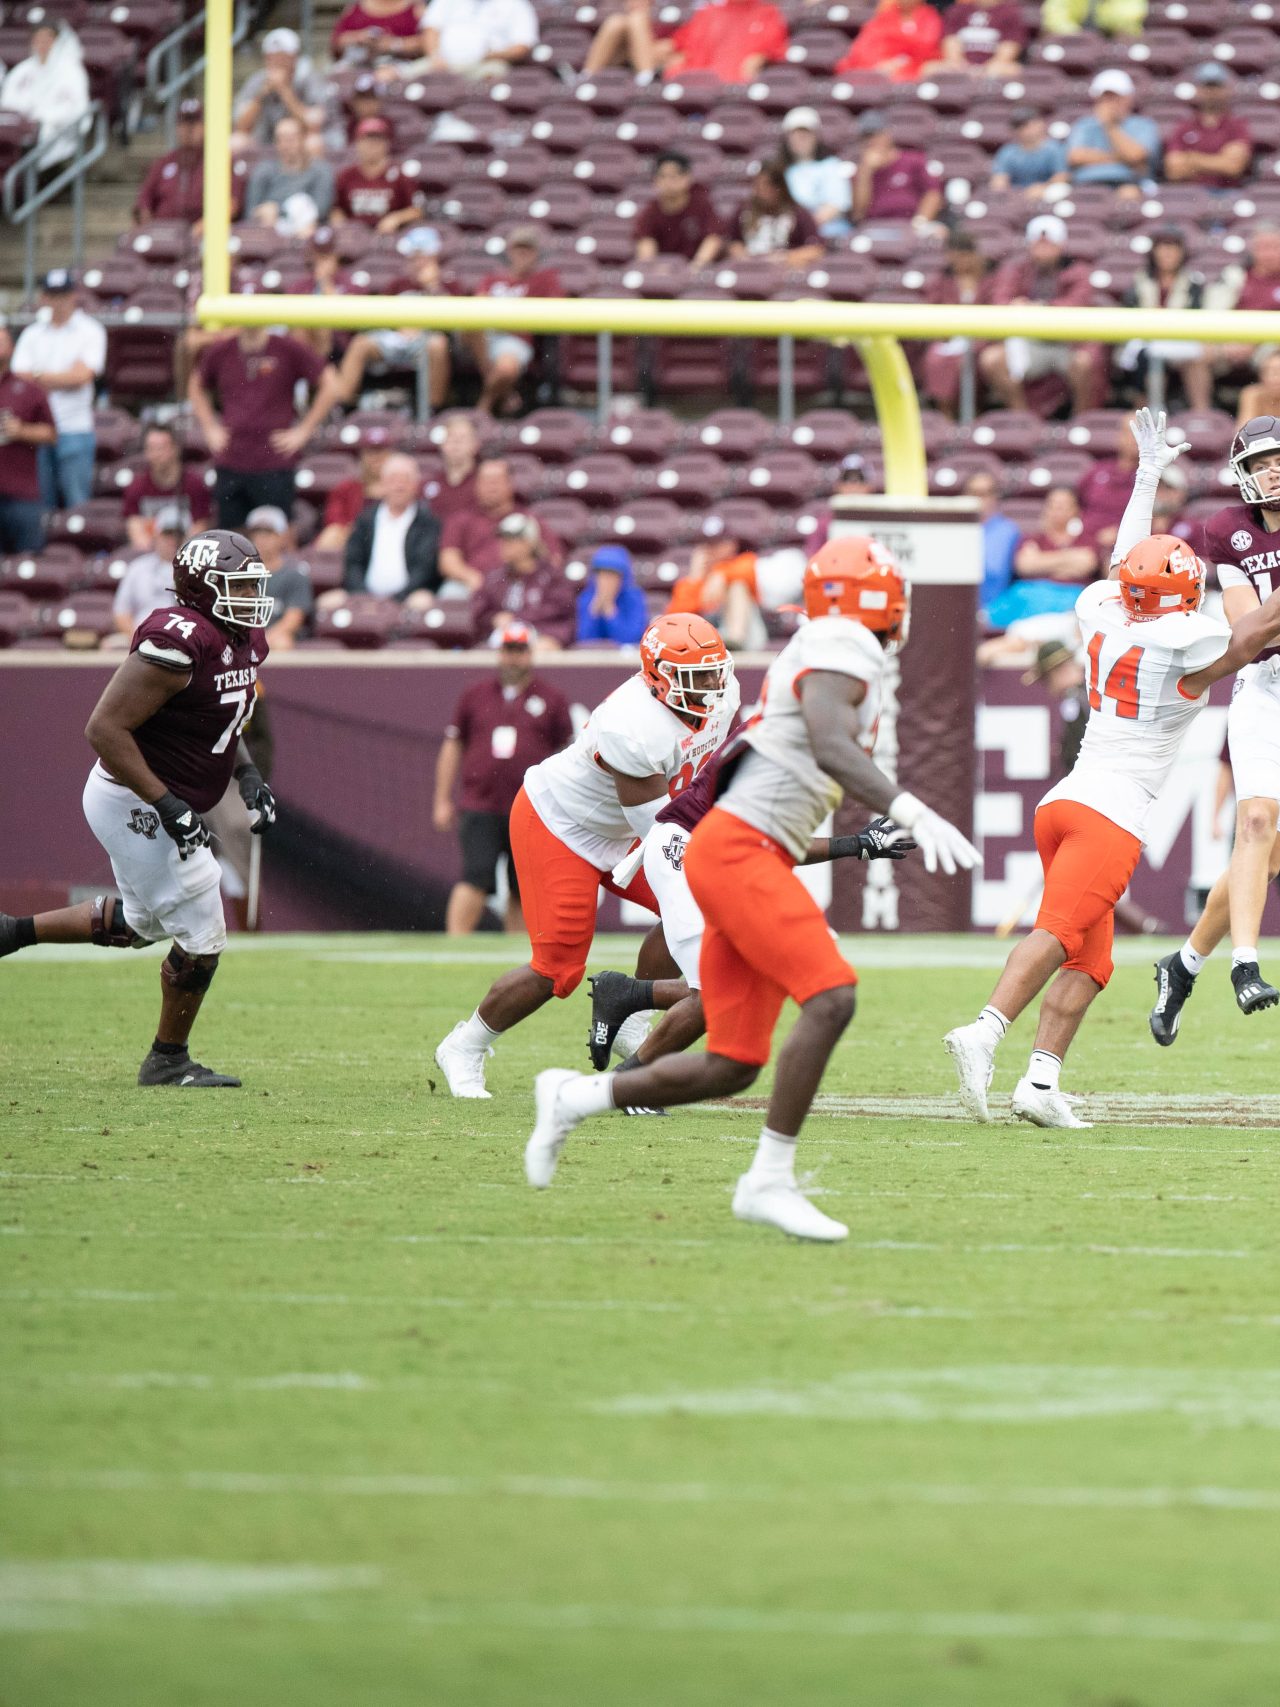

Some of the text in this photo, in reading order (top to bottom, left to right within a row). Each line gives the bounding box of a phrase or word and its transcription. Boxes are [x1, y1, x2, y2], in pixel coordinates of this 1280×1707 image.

[1231, 531, 1252, 550] SEC
[163, 613, 198, 639] 74
[213, 669, 250, 691] TEXAS
[1086, 630, 1146, 720] 14
[692, 736, 719, 757] HOUSTON
[868, 829, 883, 851] adidas
